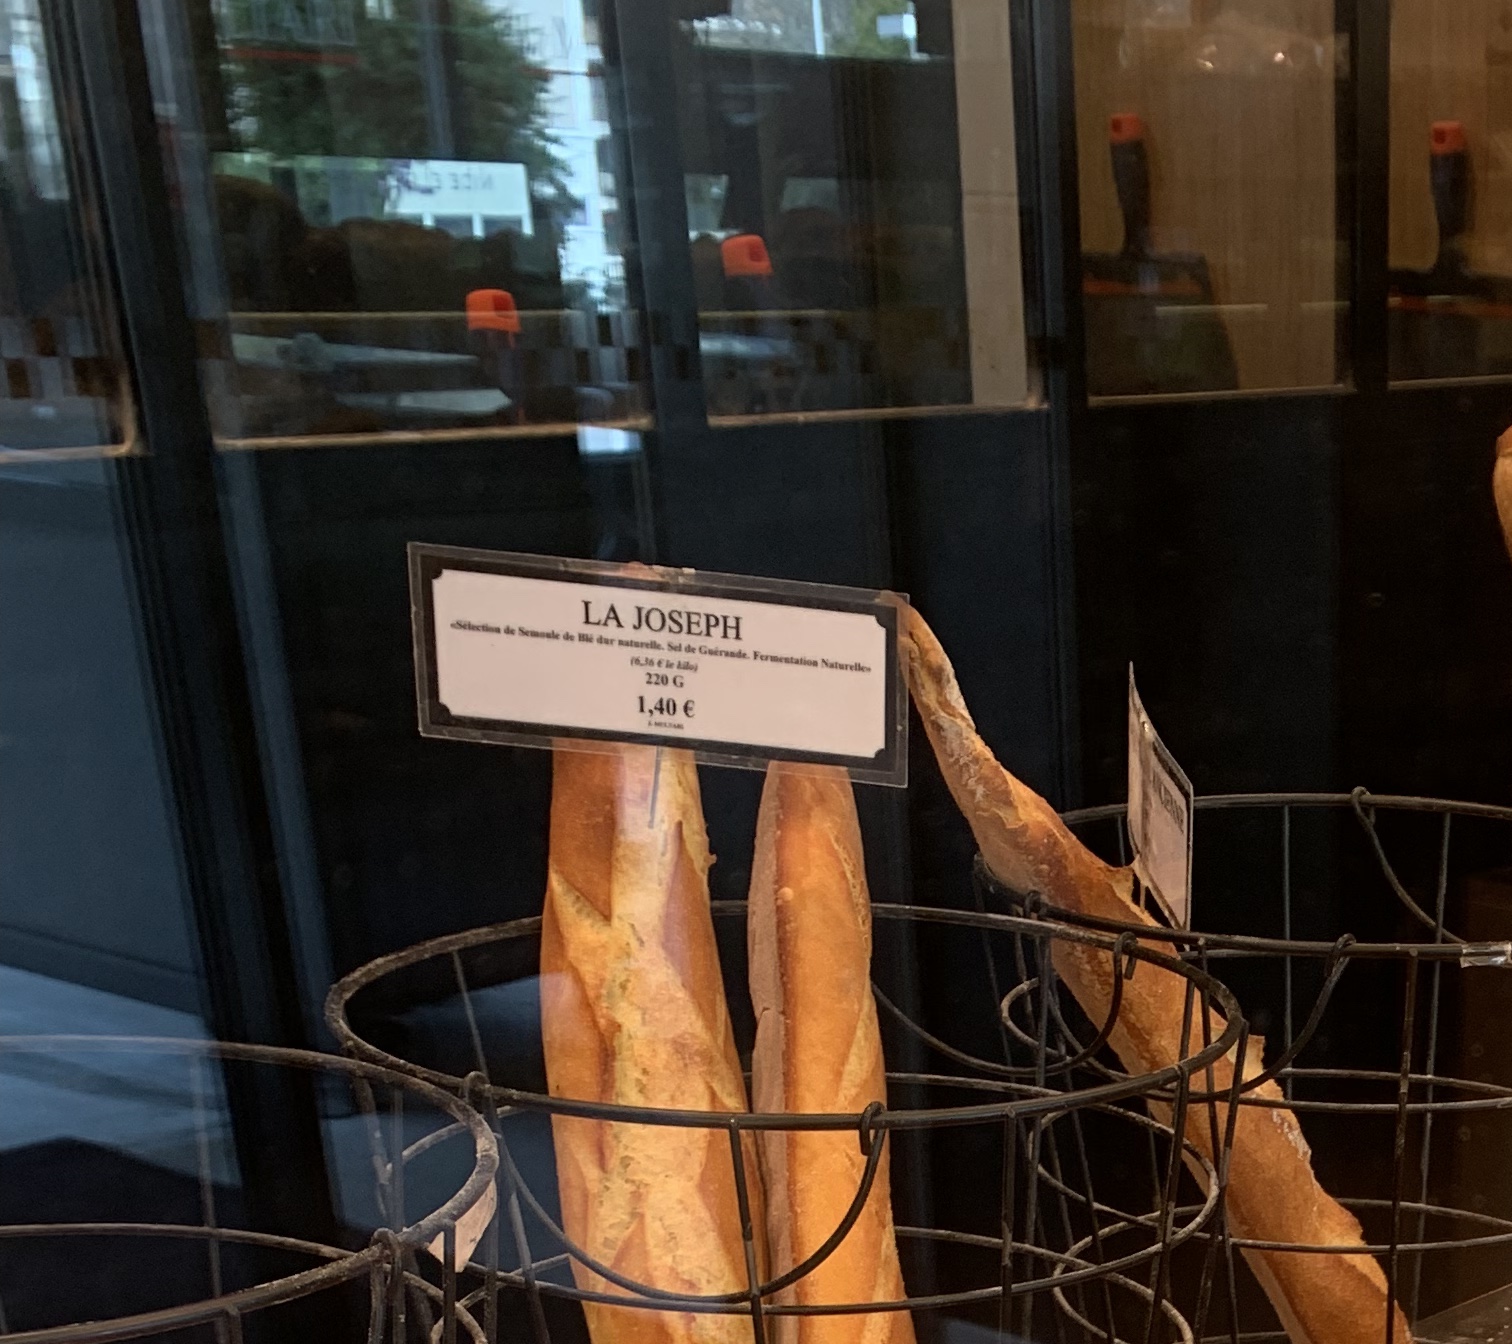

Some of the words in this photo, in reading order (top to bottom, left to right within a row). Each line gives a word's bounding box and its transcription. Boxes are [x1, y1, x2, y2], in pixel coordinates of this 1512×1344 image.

[582, 600, 624, 628] LA
[632, 605, 743, 640] JOSEPH
[504, 626, 515, 635] de
[518, 627, 560, 641] Semoule
[563, 631, 575, 642] de
[578, 633, 593, 644] Blé
[596, 635, 616, 646] dur
[618, 639, 665, 651] naturelle.
[667, 641, 683, 653] Sel
[684, 644, 697, 654] de
[753, 650, 818, 668] Fermentation
[645, 672, 669, 687] 220
[672, 675, 685, 688] G
[638, 695, 677, 717] 1,40
[682, 699, 696, 718] €
